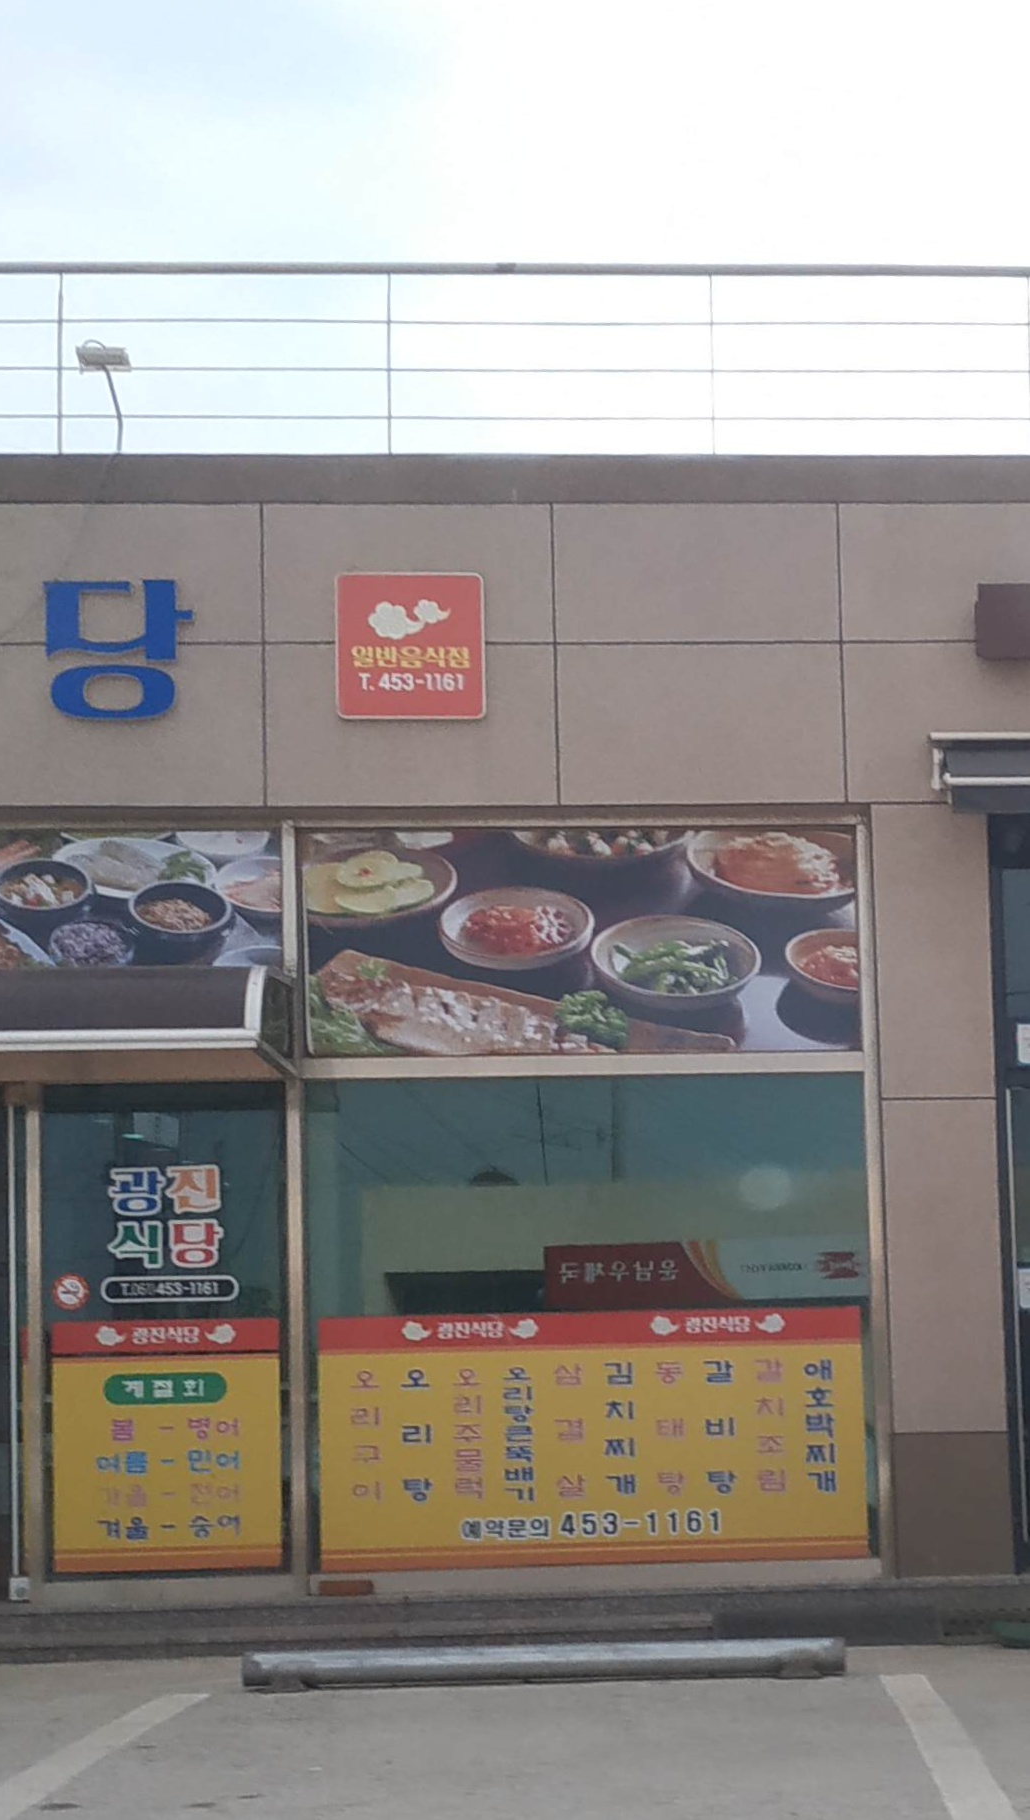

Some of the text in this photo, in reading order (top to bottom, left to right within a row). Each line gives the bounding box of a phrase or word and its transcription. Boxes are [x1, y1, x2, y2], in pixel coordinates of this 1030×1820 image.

[350, 645, 471, 668] 일반음식점
[379, 672, 464, 692] 453-1161
[108, 1164, 221, 1217] 광진
[107, 1218, 224, 1269] 식당
[400, 1368, 431, 1501] 오리탕
[554, 1364, 585, 1498] 삼겹살
[604, 1362, 637, 1495] 김치찌개
[703, 1359, 738, 1494] 갈비탕
[804, 1359, 837, 1492] 애호박찌개
[461, 1510, 722, 1540] 예약문의 453-1161
